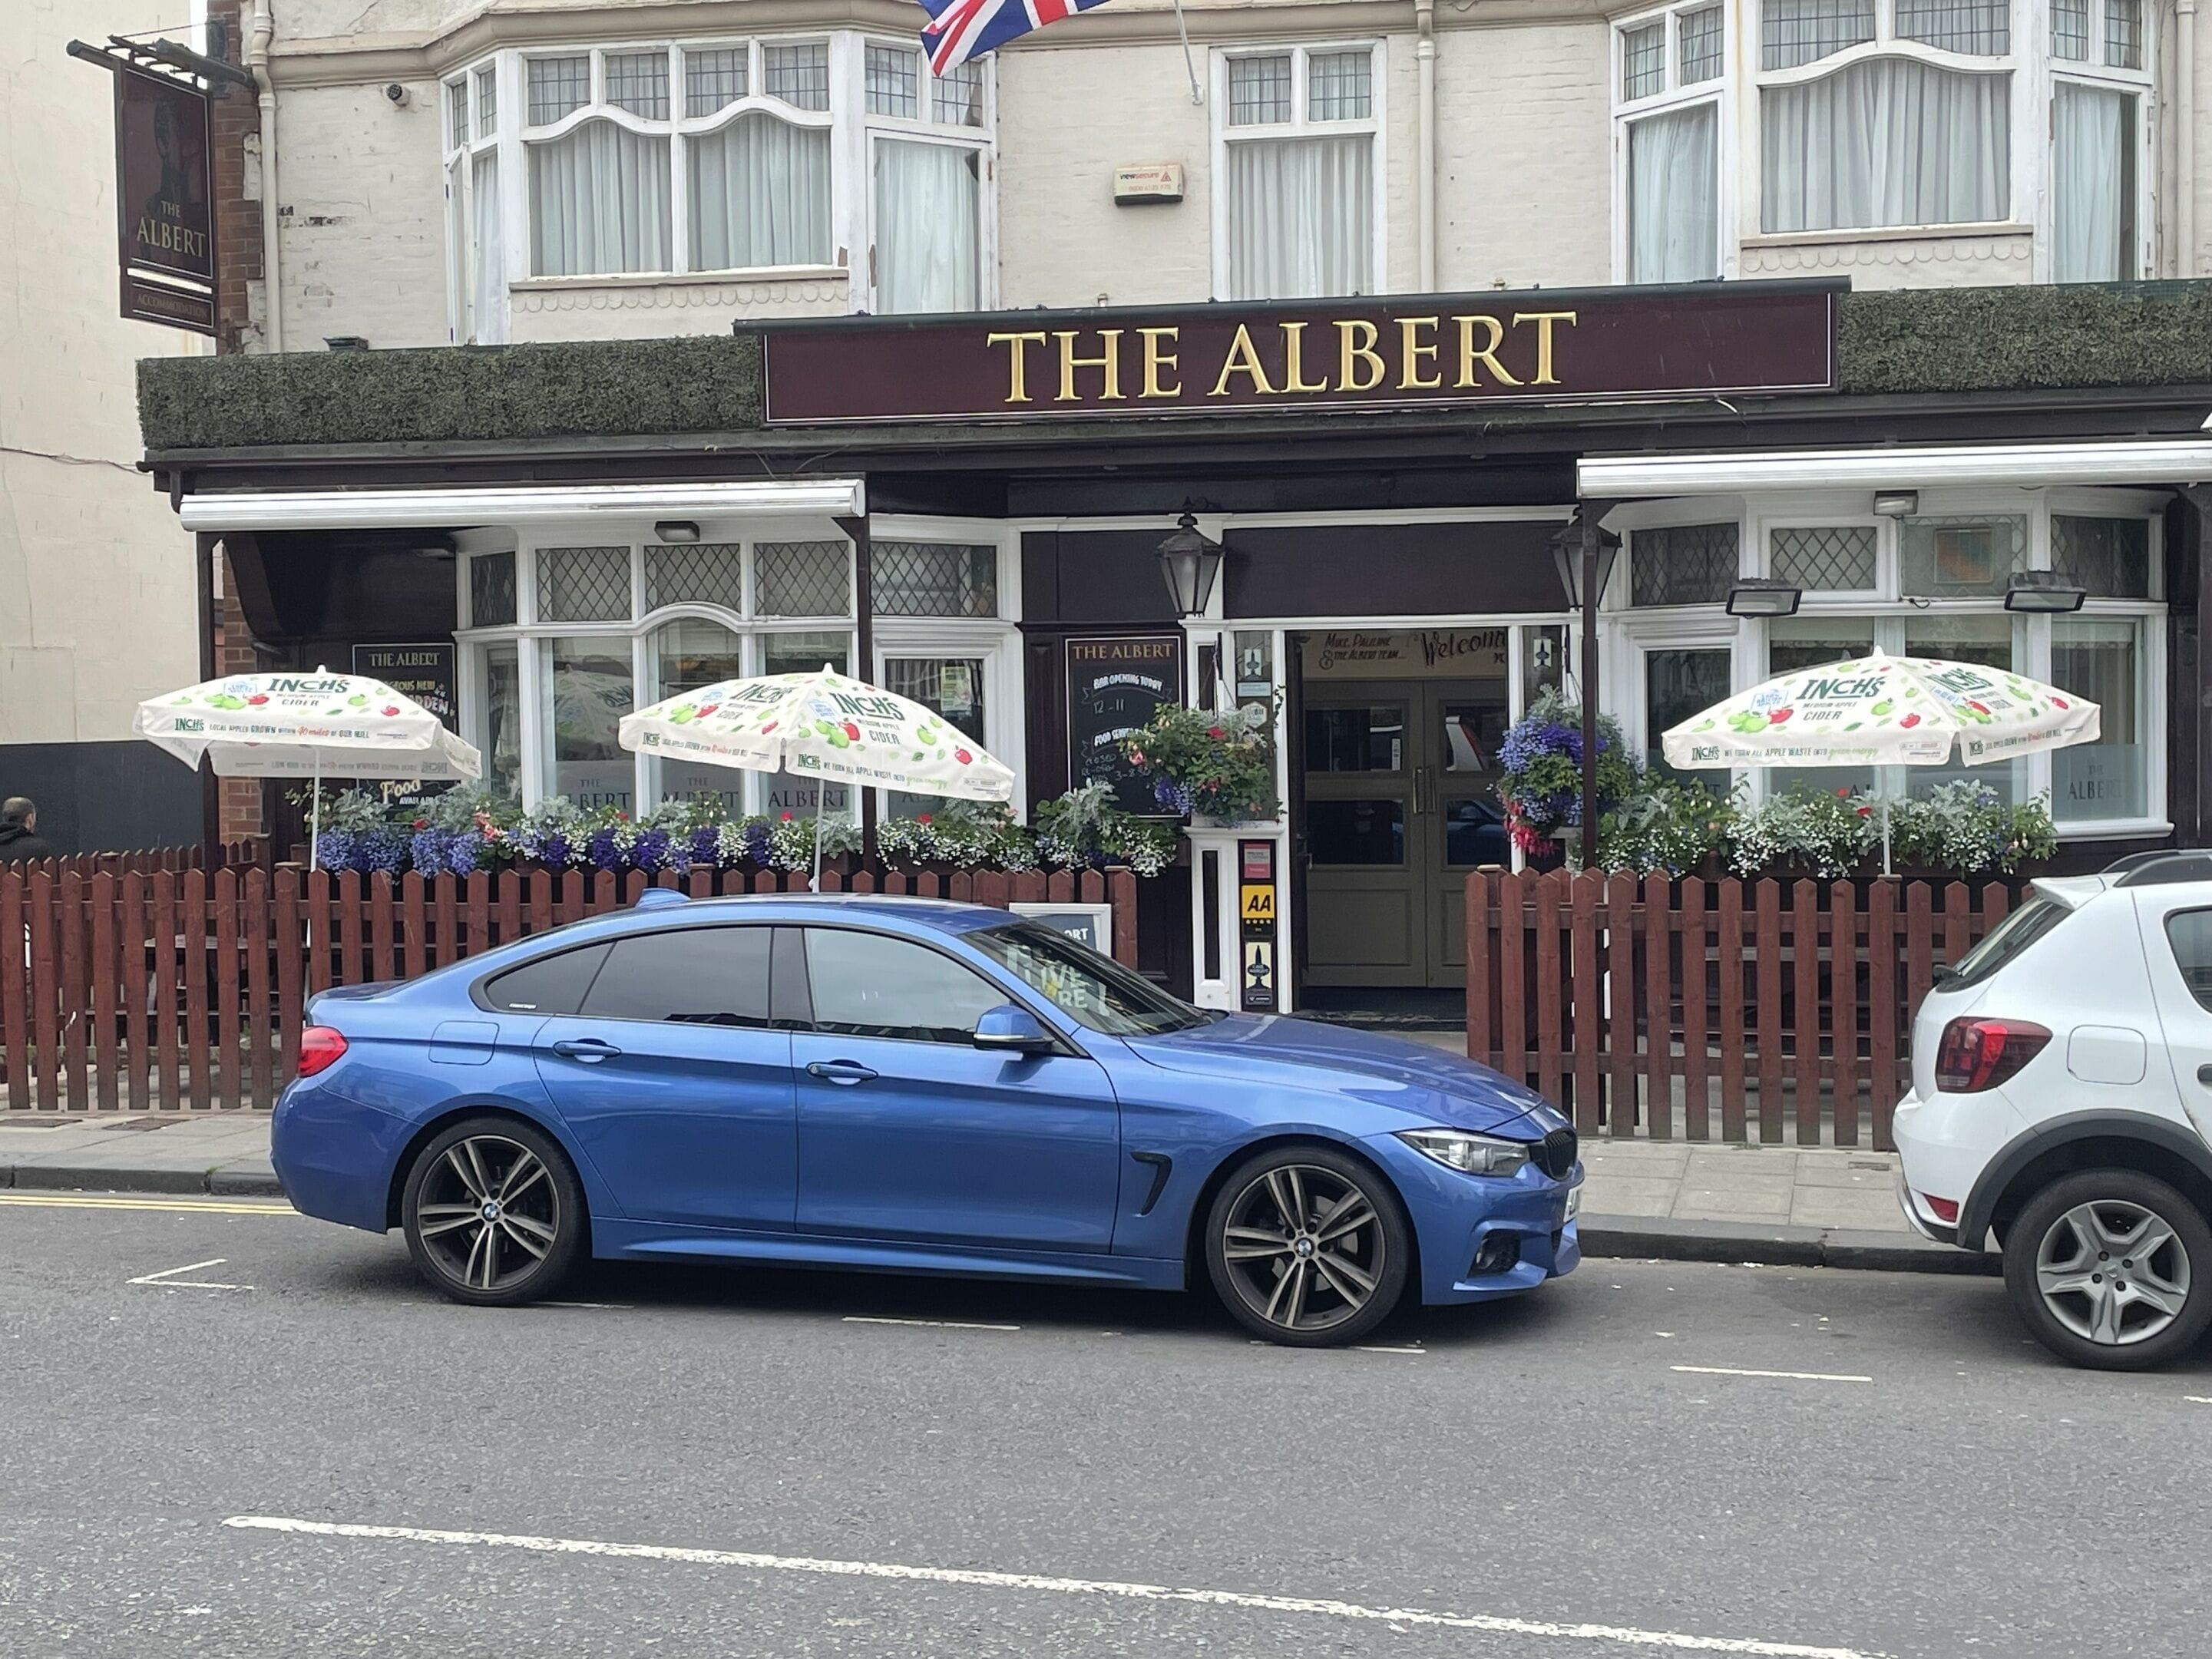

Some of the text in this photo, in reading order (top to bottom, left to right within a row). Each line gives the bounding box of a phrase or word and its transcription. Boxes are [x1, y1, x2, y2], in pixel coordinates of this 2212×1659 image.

[161, 200, 181, 218] THE
[137, 216, 206, 257] ALBERT
[137, 293, 207, 318] ACCOMMODATION
[986, 311, 1577, 403] THE ALBERT
[1073, 643, 1174, 659] THE ALBERT
[369, 652, 441, 667] THE ALBERT
[267, 677, 350, 693] INCH'S
[416, 679, 435, 691] NEW
[1093, 673, 1162, 692] BAR OPENING TODAY
[1924, 667, 1994, 692] INCH'S
[1795, 676, 1889, 700] INCH'S
[828, 692, 905, 721] INCH'S
[1803, 711, 1843, 721] CIDER
[175, 718, 203, 731] INCH'S
[250, 725, 276, 733] GROWN
[868, 729, 900, 745] CIDER
[1094, 732, 1111, 747] FOOD
[1691, 745, 1720, 761] INCH'S
[1766, 748, 1785, 757] APPLE
[1788, 747, 1811, 756] WASTE
[798, 754, 820, 770] INCH'S
[856, 765, 872, 777] APPLE
[579, 779, 600, 788] THE
[687, 777, 708, 787] THE
[769, 790, 849, 808] ALBERT
[1247, 895, 1271, 911] AA
